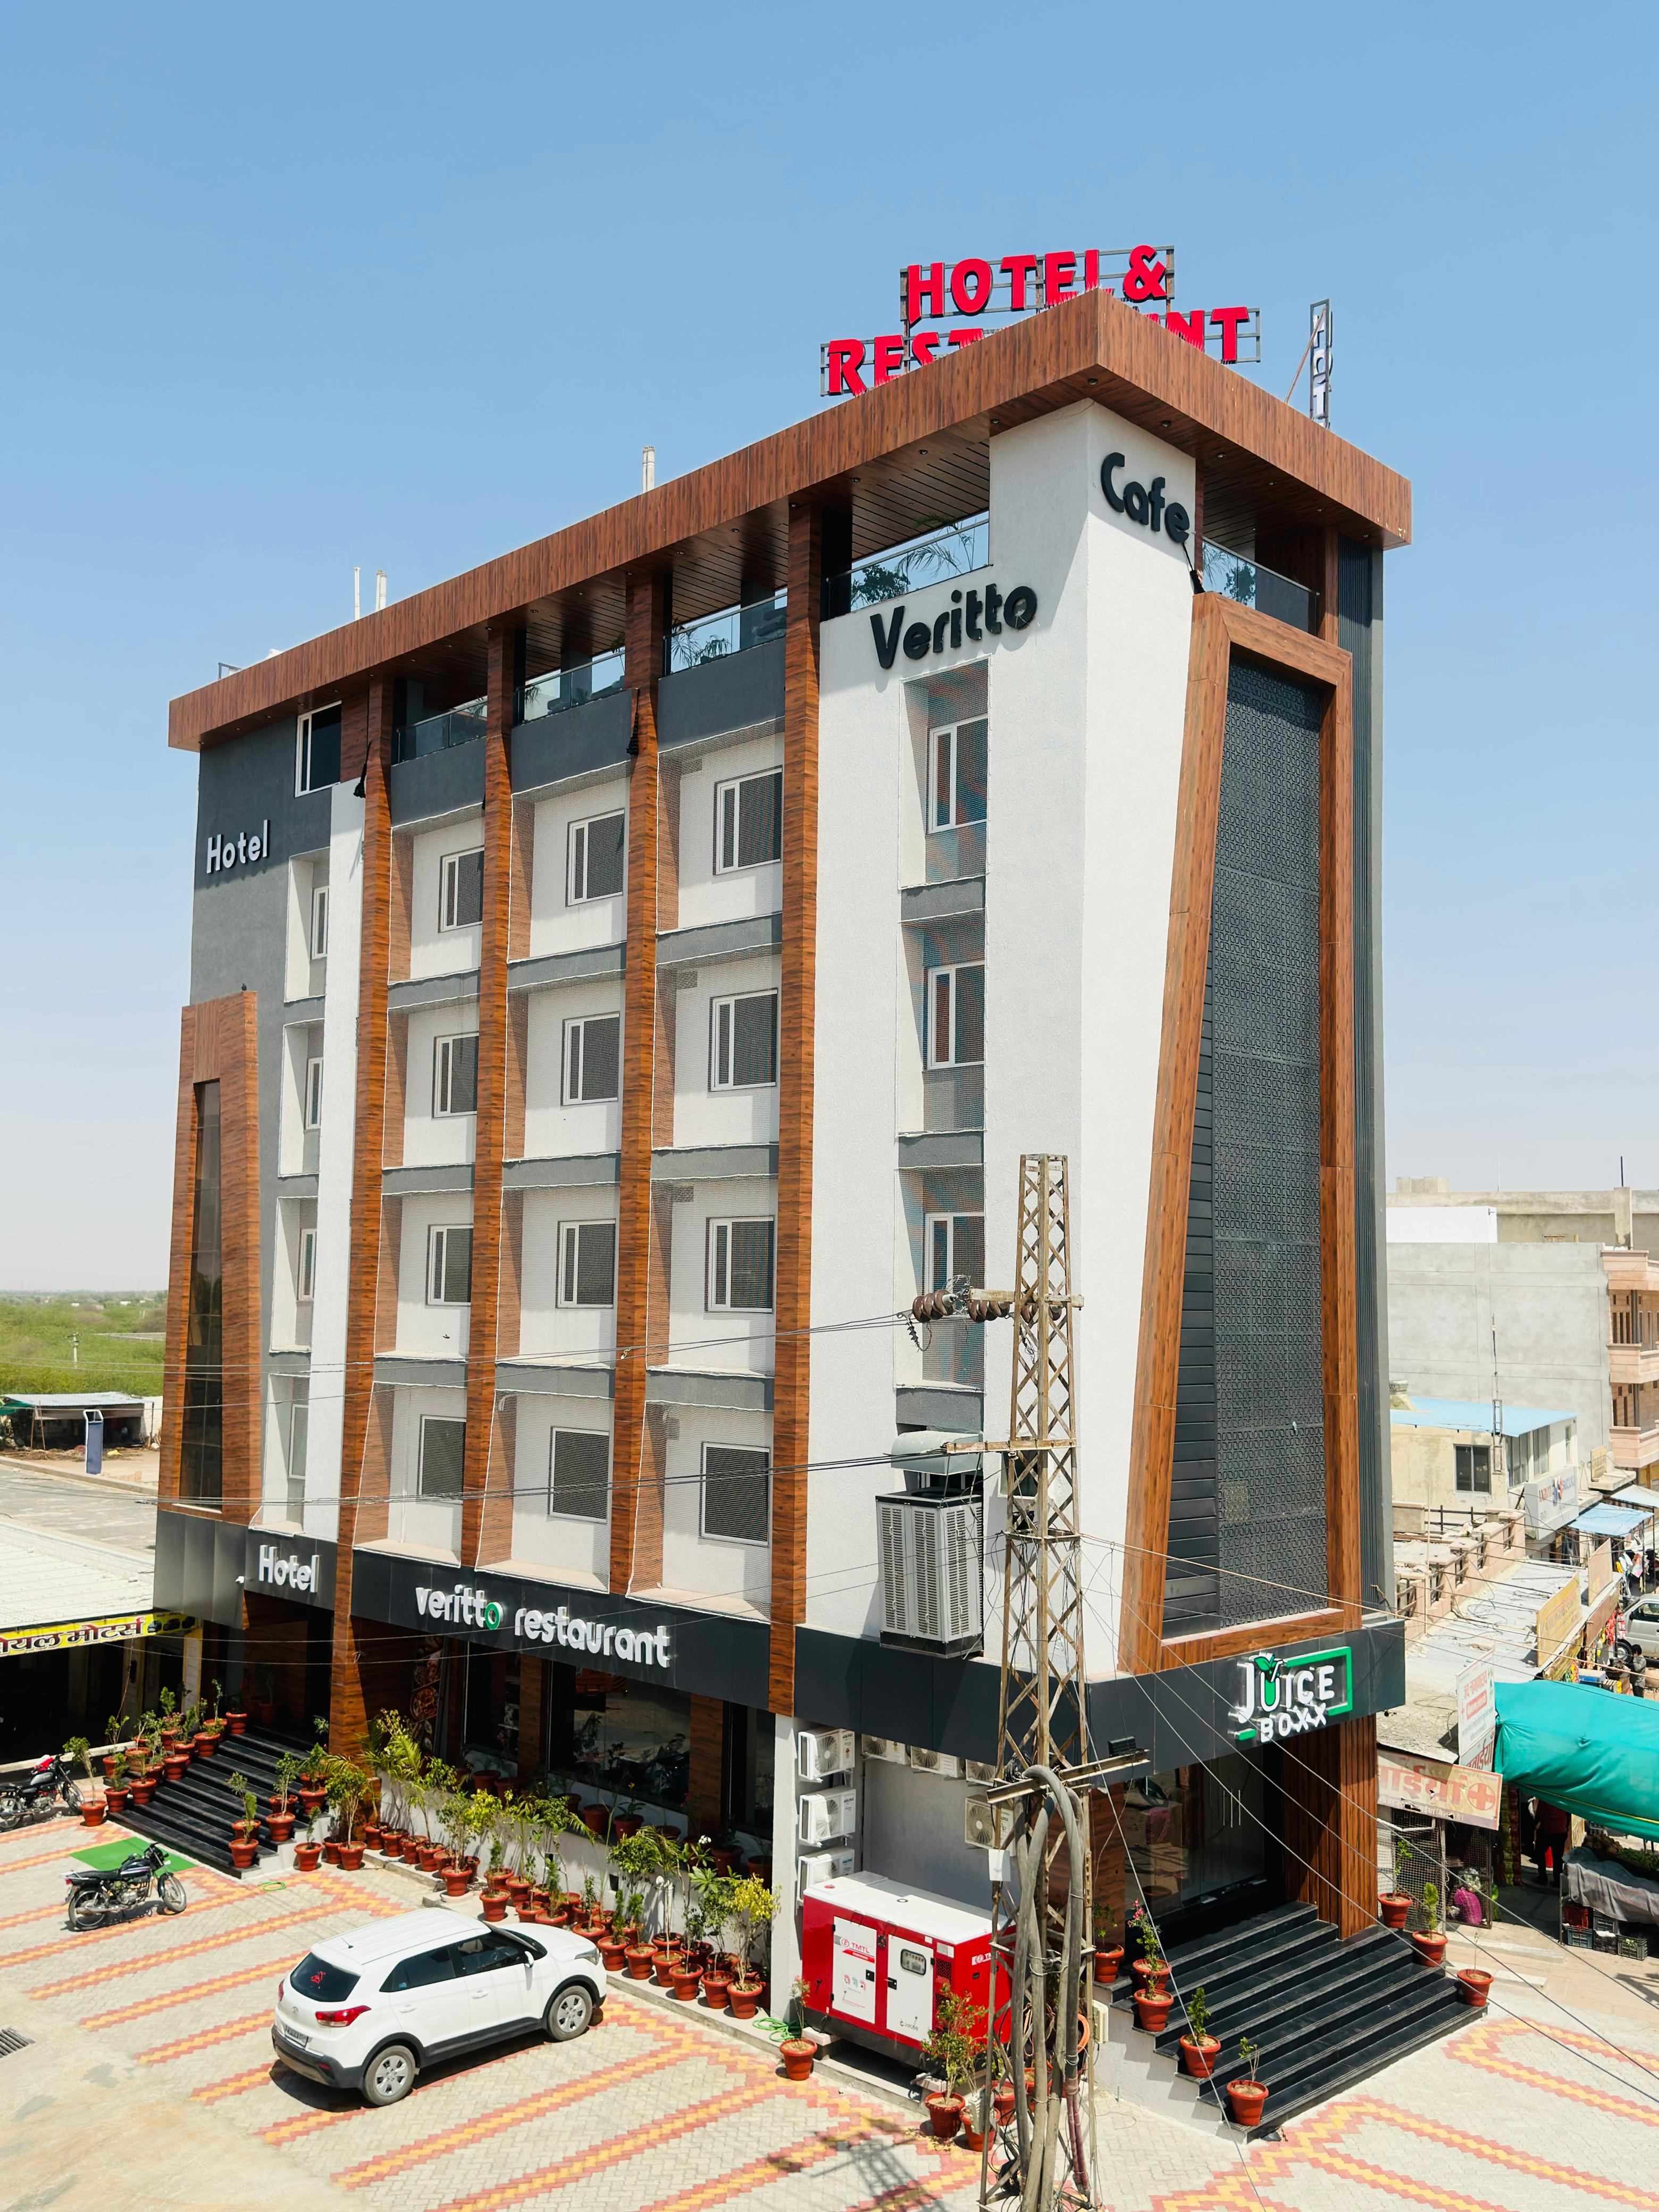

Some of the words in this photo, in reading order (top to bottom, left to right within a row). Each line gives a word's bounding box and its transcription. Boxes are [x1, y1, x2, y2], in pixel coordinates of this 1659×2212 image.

[907, 249, 1115, 324] HOTEL
[1122, 245, 1168, 303] &
[1101, 452, 1190, 543] Cafe
[869, 583, 1037, 669] Veritto
[206, 819, 270, 874] Hotel
[258, 1544, 320, 1593] Hotel
[66, 1616, 146, 1644] मोटर्स
[415, 1584, 504, 1630] veritto
[514, 1606, 671, 1668] restaurant
[1236, 1662, 1335, 1724] JUICE
[1260, 1702, 1327, 1744] BOXX
[851, 1942, 870, 1954] TMTL
